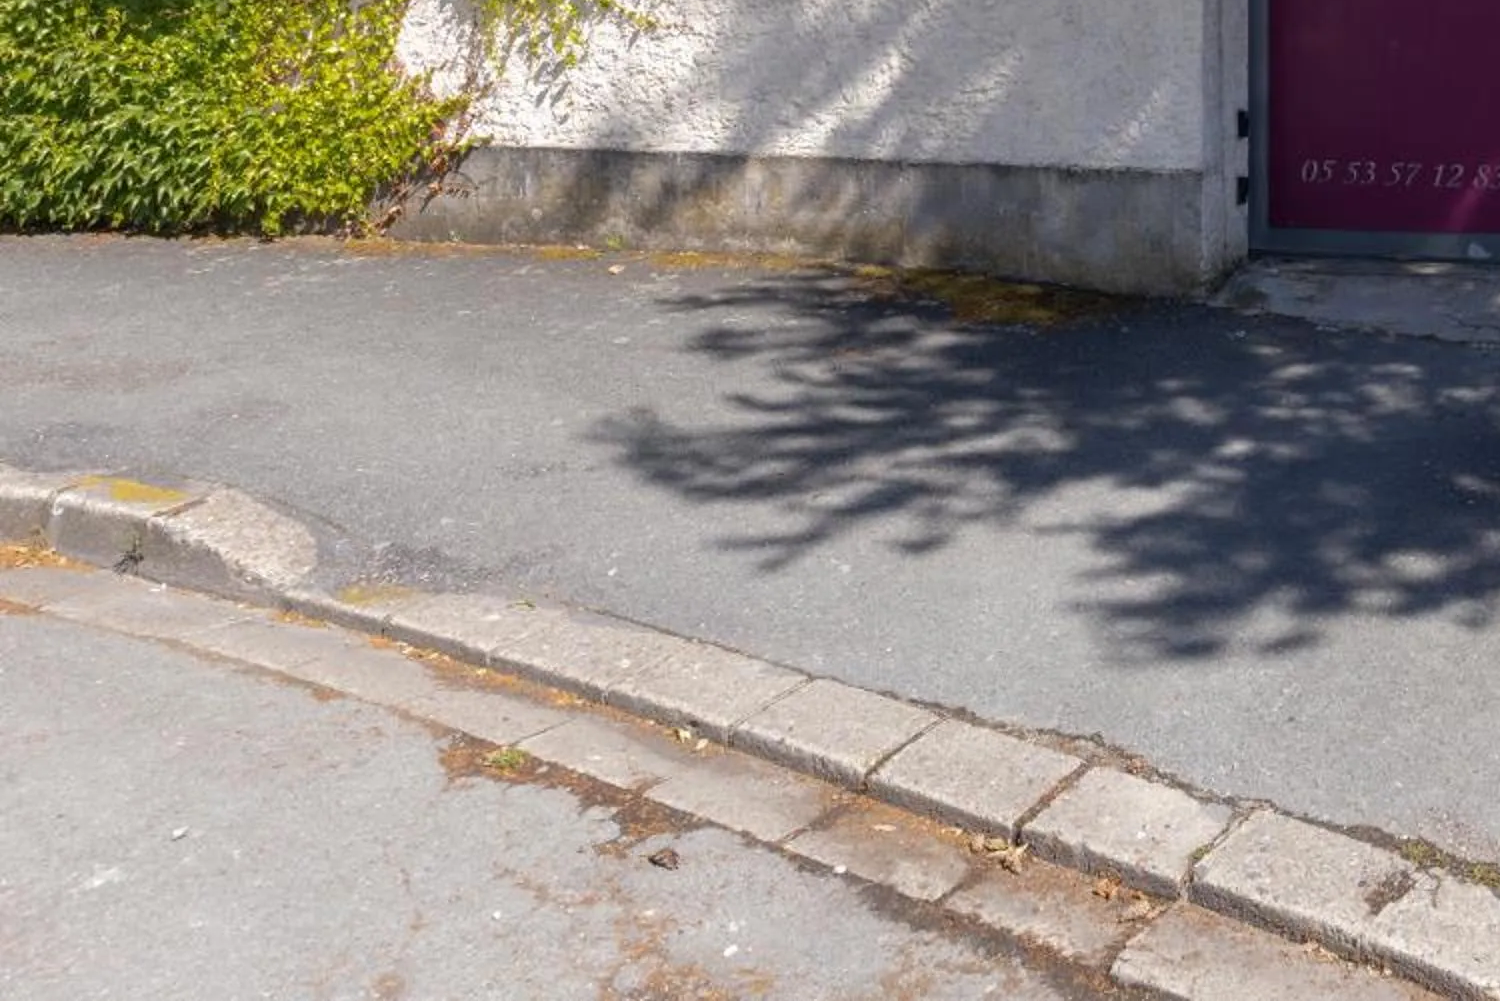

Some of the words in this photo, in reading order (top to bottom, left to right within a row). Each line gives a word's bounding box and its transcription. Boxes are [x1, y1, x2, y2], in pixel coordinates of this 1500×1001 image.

[1301, 159, 1337, 183] 05
[1343, 161, 1377, 187] 53
[1386, 162, 1423, 187] 57
[1433, 163, 1466, 188] 12
